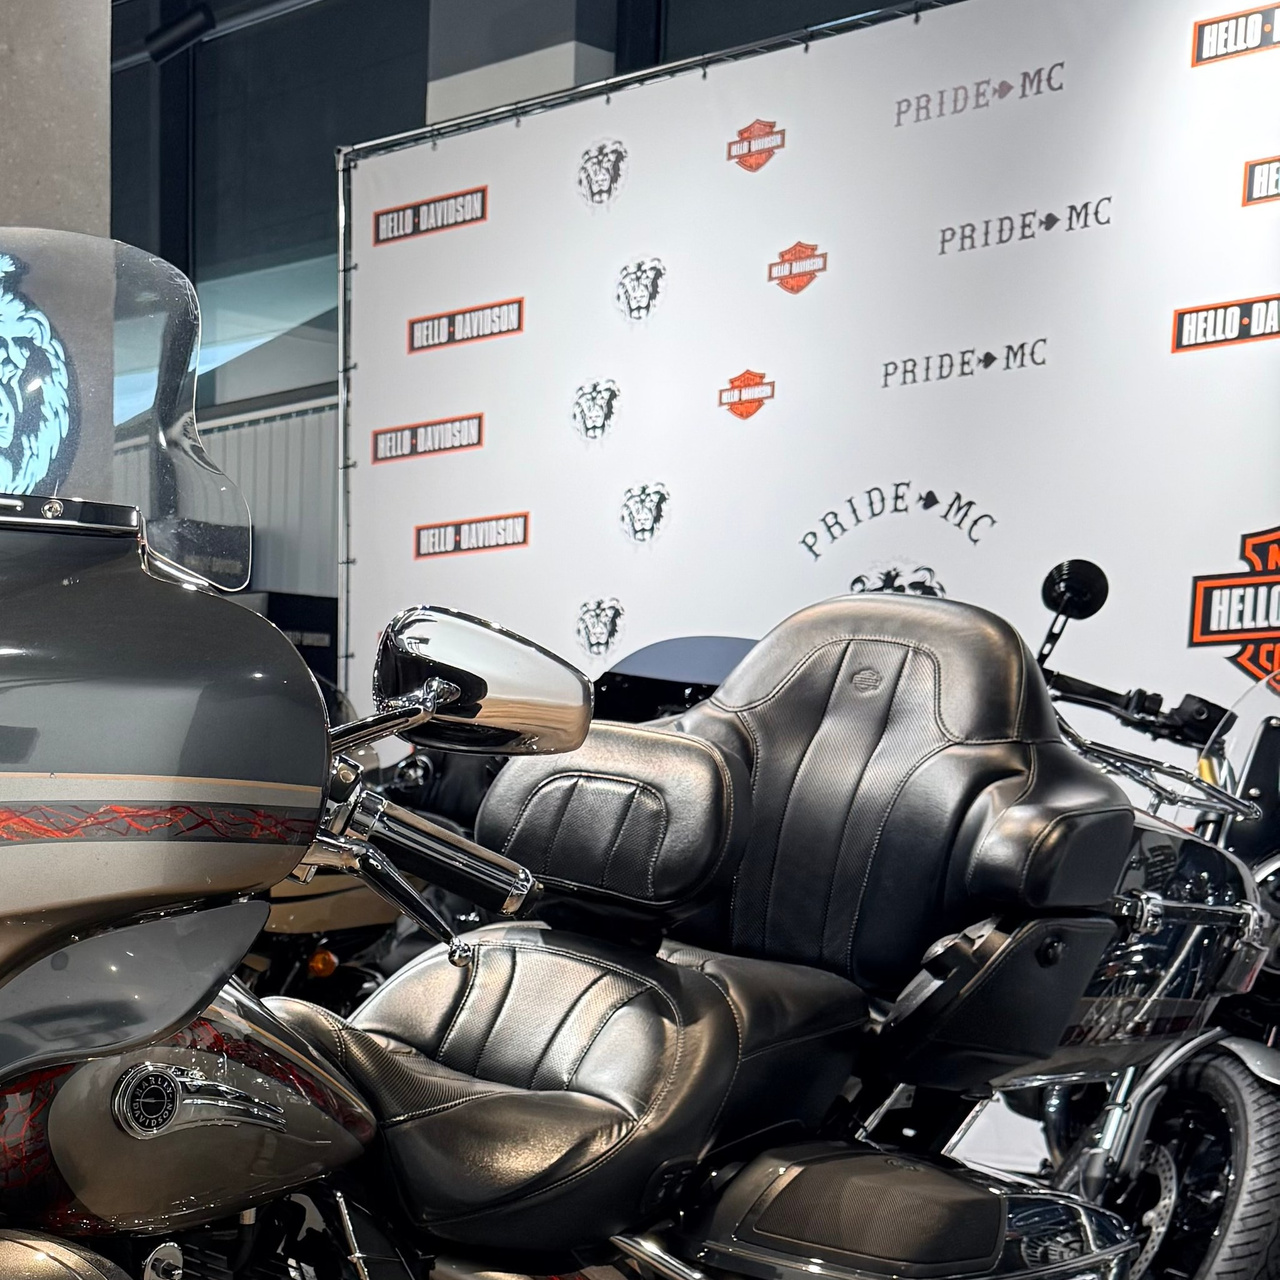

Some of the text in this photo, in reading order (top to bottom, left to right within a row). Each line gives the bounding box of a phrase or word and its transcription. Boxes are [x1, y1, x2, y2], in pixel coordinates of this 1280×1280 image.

[1202, 13, 1263, 59] HELLO
[894, 61, 1065, 128] PRIDE MC
[378, 191, 483, 240] HELLO DAVIDSON
[938, 196, 1112, 255] PRIDE MC
[413, 302, 519, 348] HELLO DAVIDSON
[1182, 306, 1240, 346] HELLO
[881, 338, 1047, 388] PRIDE MC
[376, 417, 480, 459] HELLO DAVIDSON
[420, 516, 525, 555] HELLO DAVIDSON
[799, 480, 997, 561] PRIDE MC
